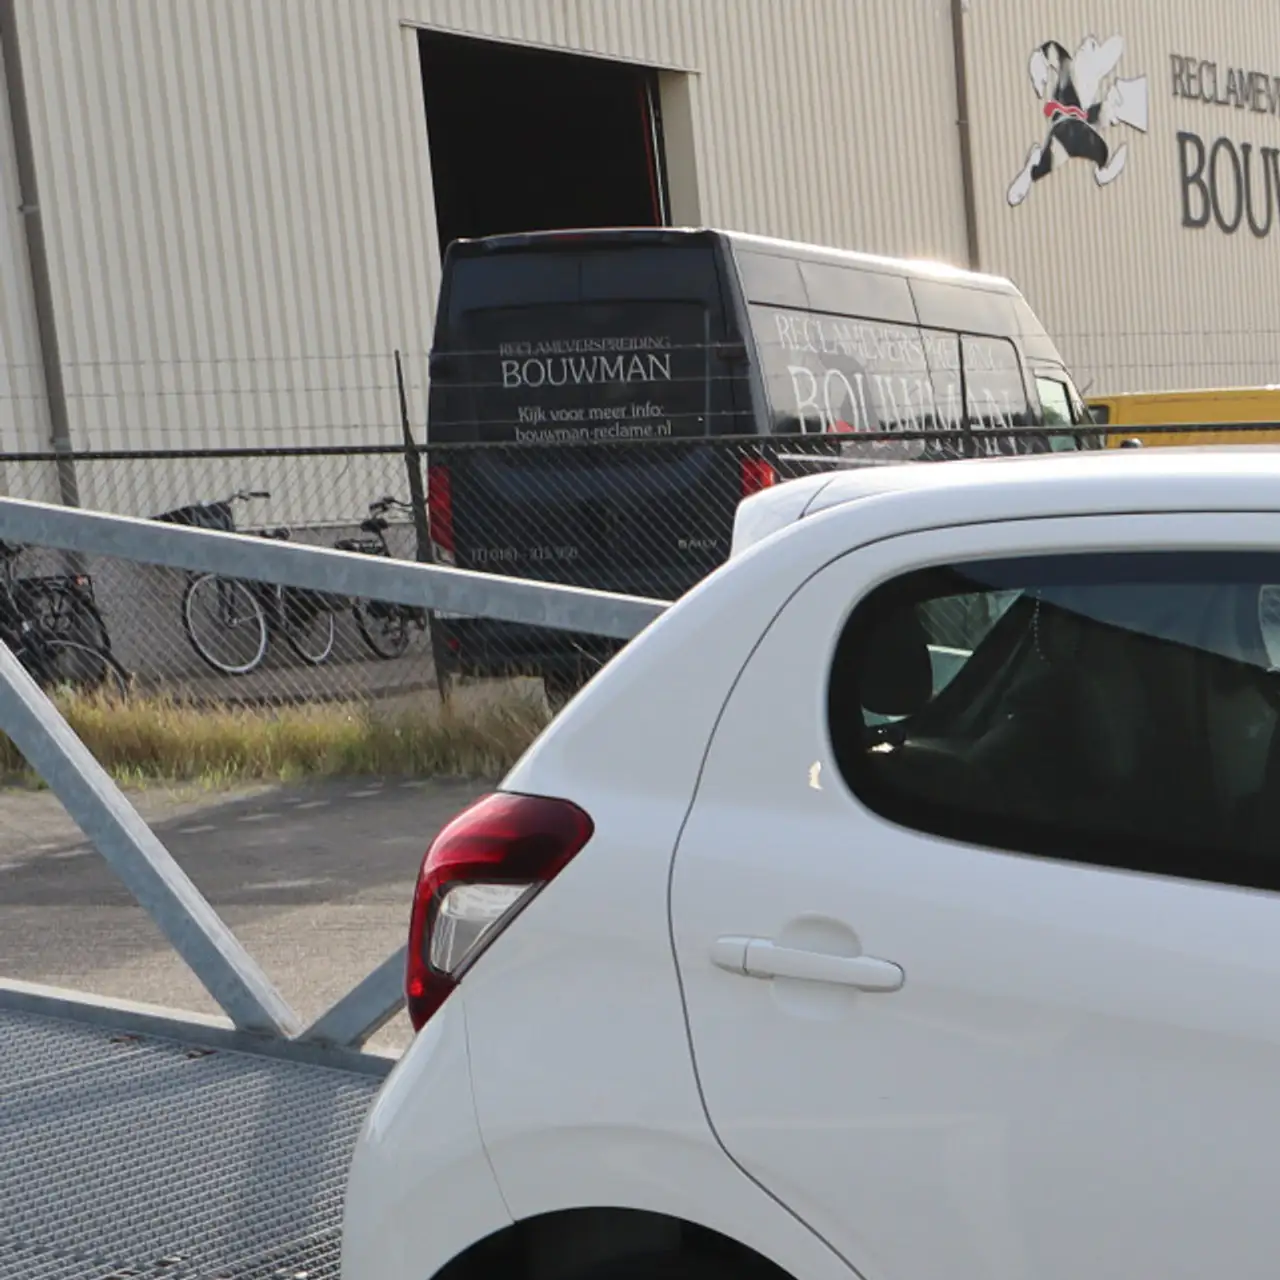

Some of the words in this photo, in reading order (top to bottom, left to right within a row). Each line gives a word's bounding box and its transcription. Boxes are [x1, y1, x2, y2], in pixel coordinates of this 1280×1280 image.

[501, 353, 673, 389] BOUWMAN
[517, 405, 547, 425] Kijk
[550, 407, 585, 422] voor
[588, 405, 627, 420] meer
[631, 400, 665, 418] info:
[786, 365, 1019, 455] BOUWMAN
